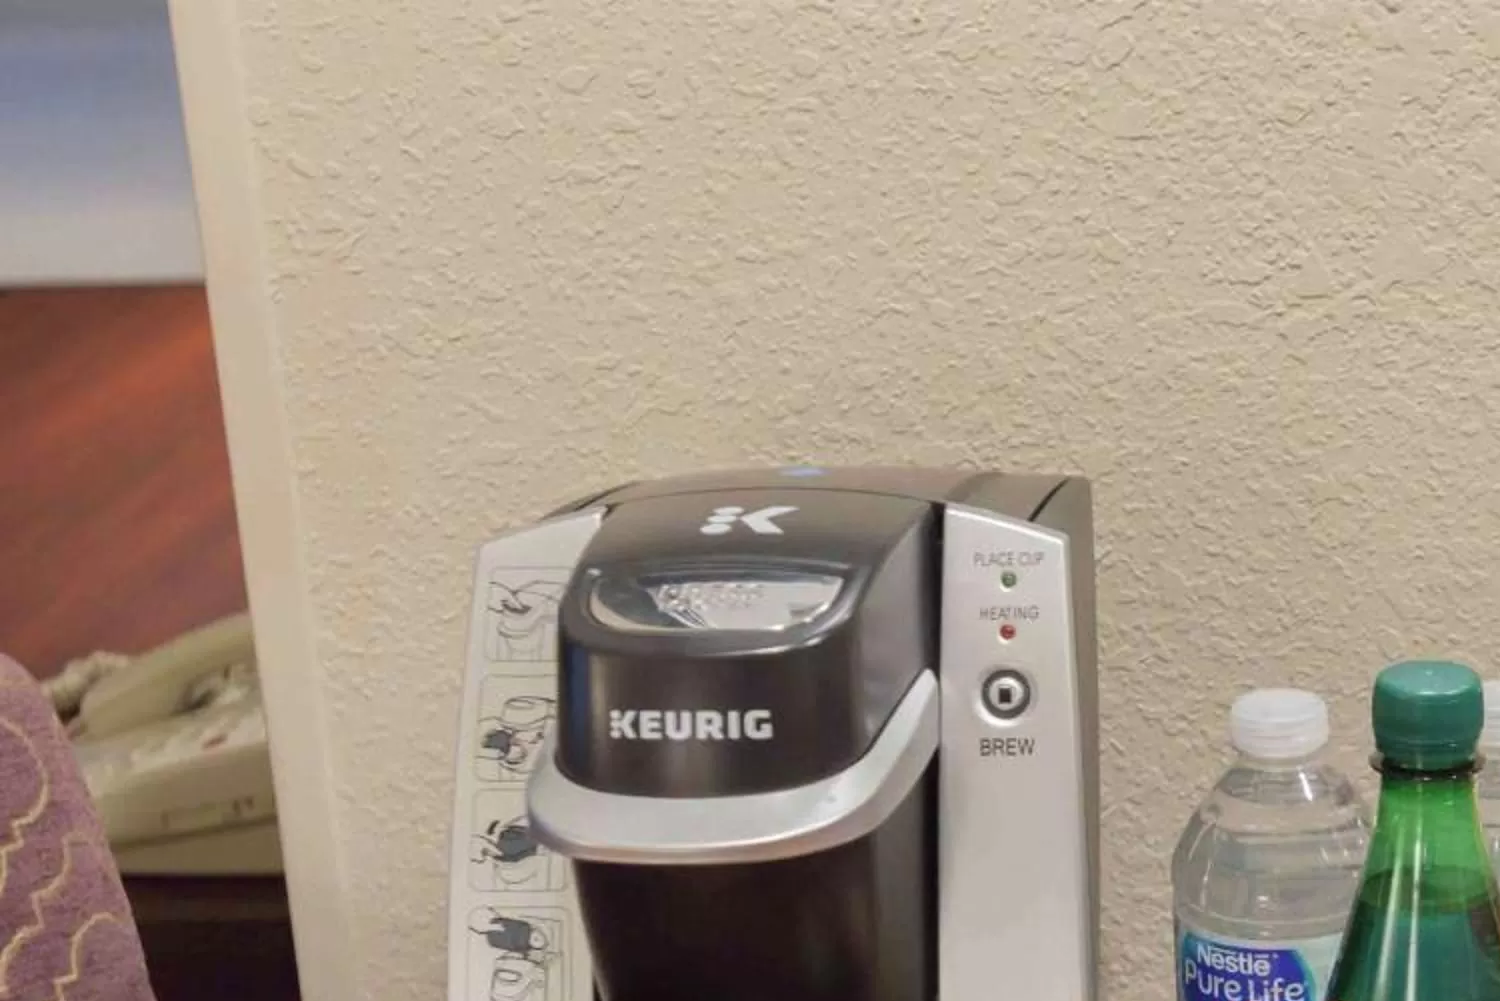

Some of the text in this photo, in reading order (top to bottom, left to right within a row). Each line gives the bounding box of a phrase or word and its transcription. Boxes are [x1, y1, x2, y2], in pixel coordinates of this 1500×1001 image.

[973, 551, 1045, 568] PLACE CUP
[978, 606, 1041, 622] HEATING
[609, 708, 774, 741] KEURIG
[978, 737, 1036, 758] BREW
